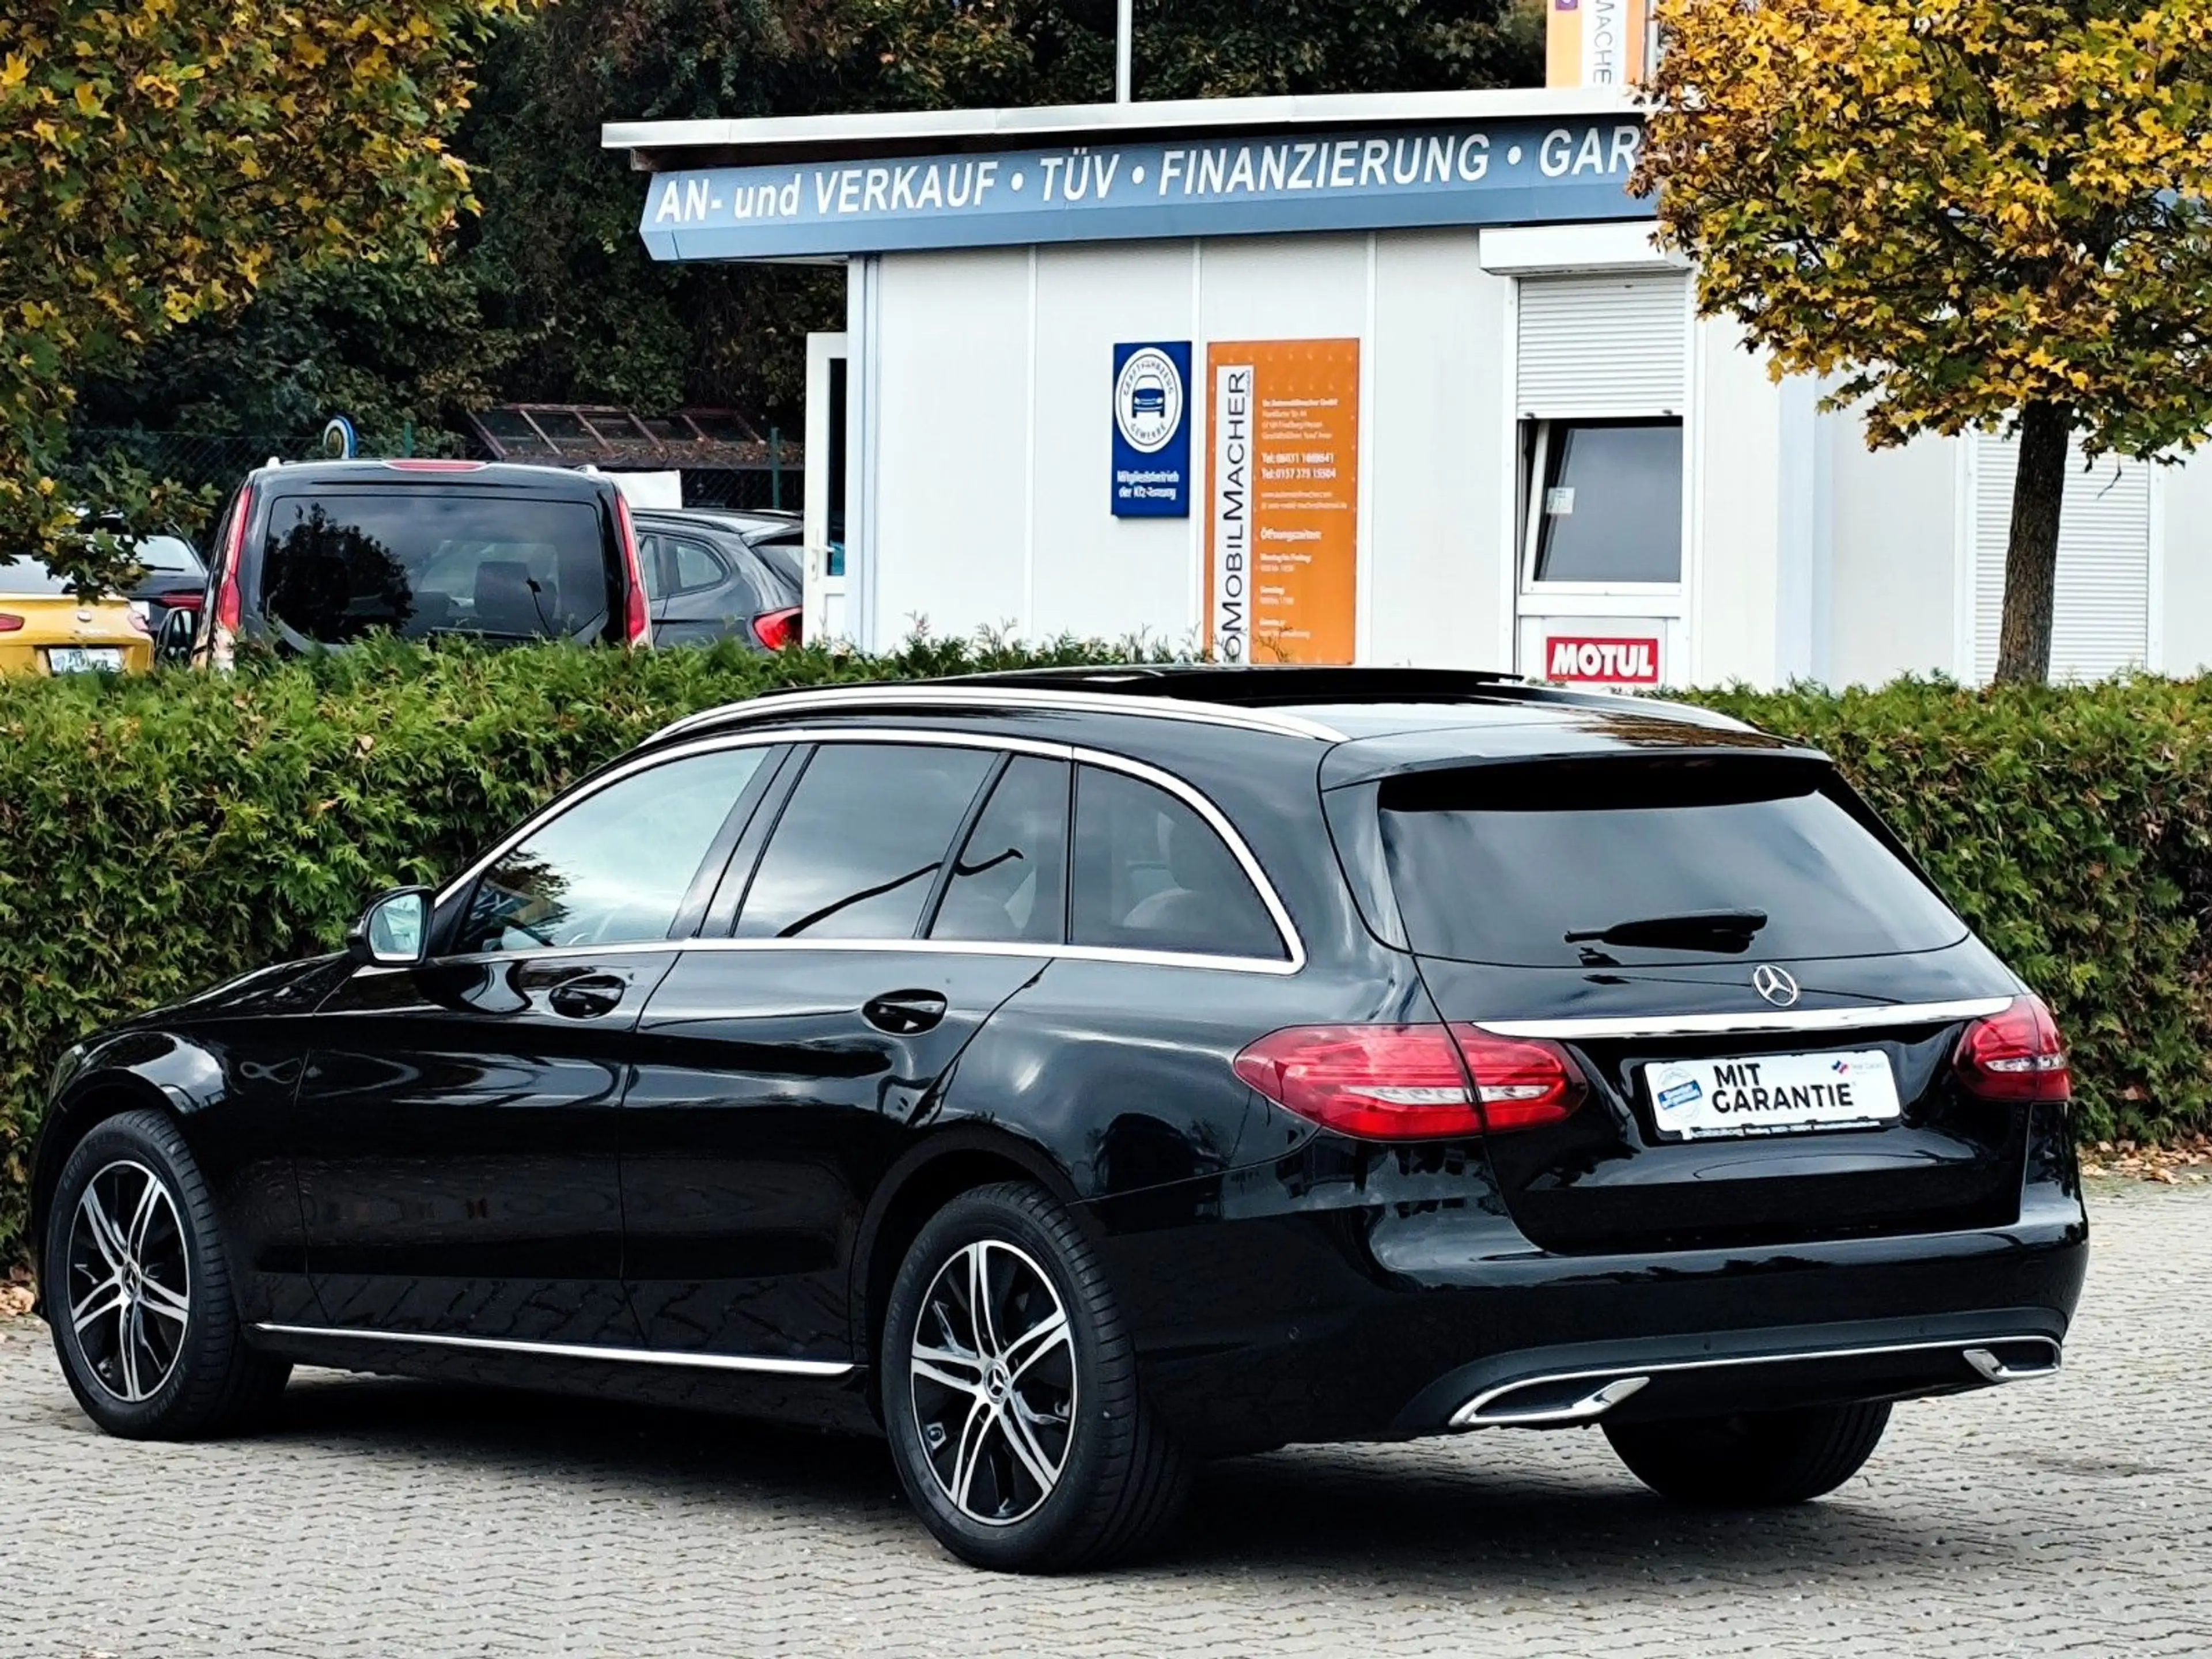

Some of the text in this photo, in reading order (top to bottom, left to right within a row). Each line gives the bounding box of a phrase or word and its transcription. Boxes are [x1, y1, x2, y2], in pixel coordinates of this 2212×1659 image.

[655, 125, 1641, 225] AN- und VERKAUF TÜV FINANZIERUNG GAR
[1551, 643, 1654, 677] MOTUL
[1713, 1063, 1760, 1088] MIT
[1712, 1083, 1853, 1113] GARANTIE
